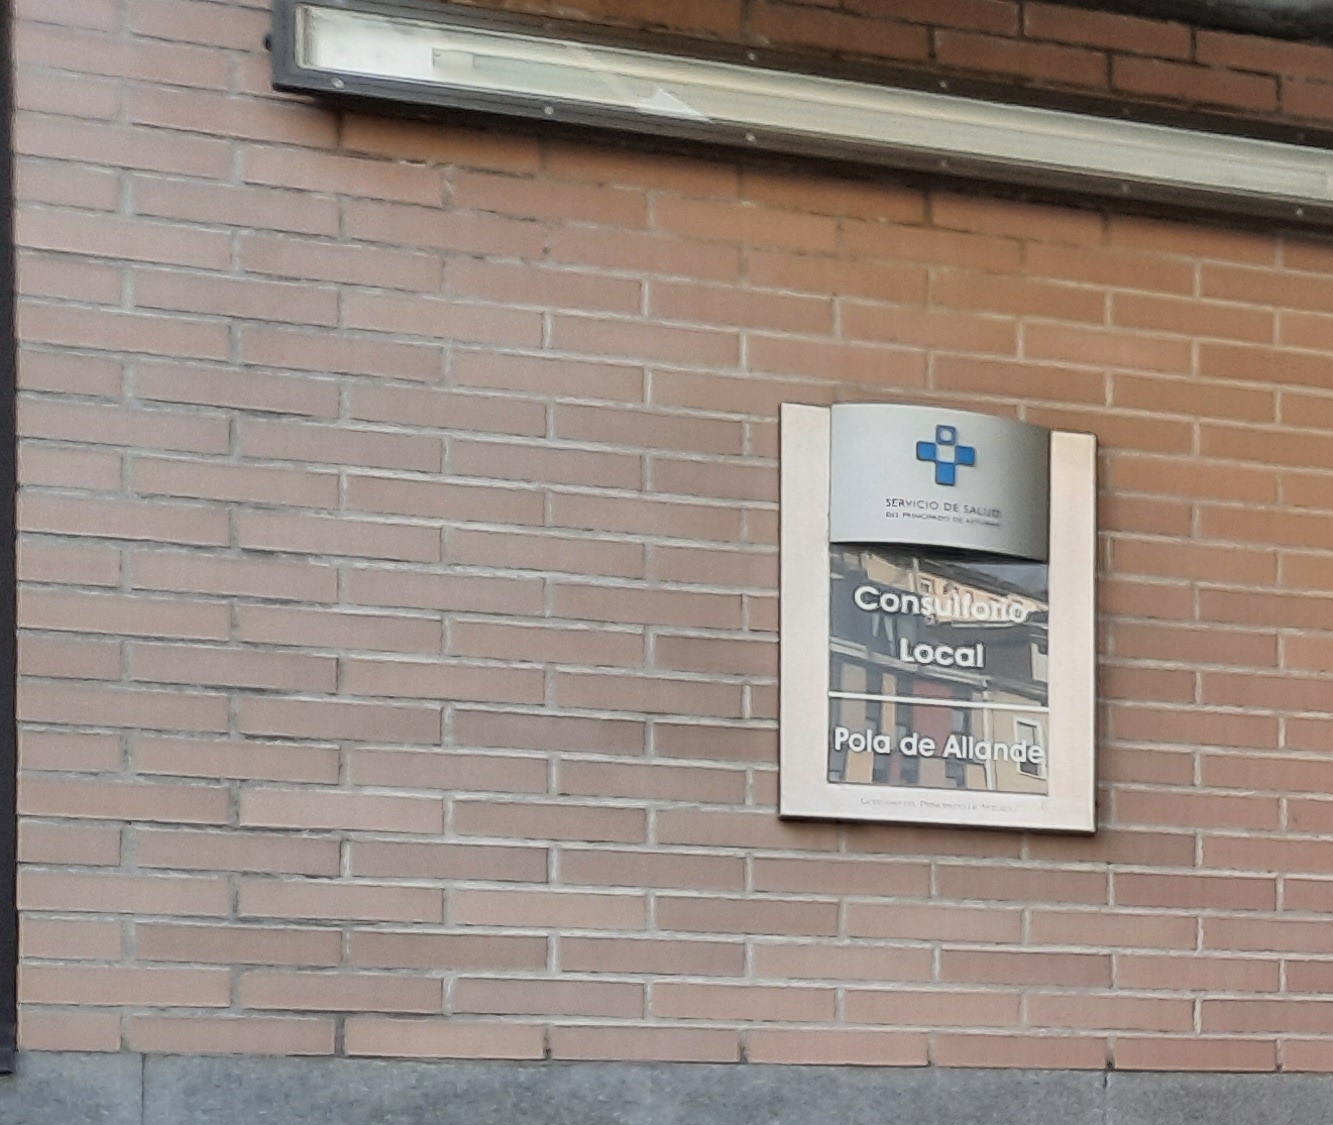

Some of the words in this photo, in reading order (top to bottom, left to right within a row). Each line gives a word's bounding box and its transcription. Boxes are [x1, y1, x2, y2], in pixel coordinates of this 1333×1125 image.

[885, 498, 939, 510] SERVICIO
[943, 502, 959, 512] DE
[963, 504, 1001, 518] SALUD
[854, 585, 1028, 622] Consultorio
[900, 638, 985, 668] Local
[834, 727, 891, 754] Pola
[900, 732, 936, 757] de
[943, 734, 1045, 764] Allande
